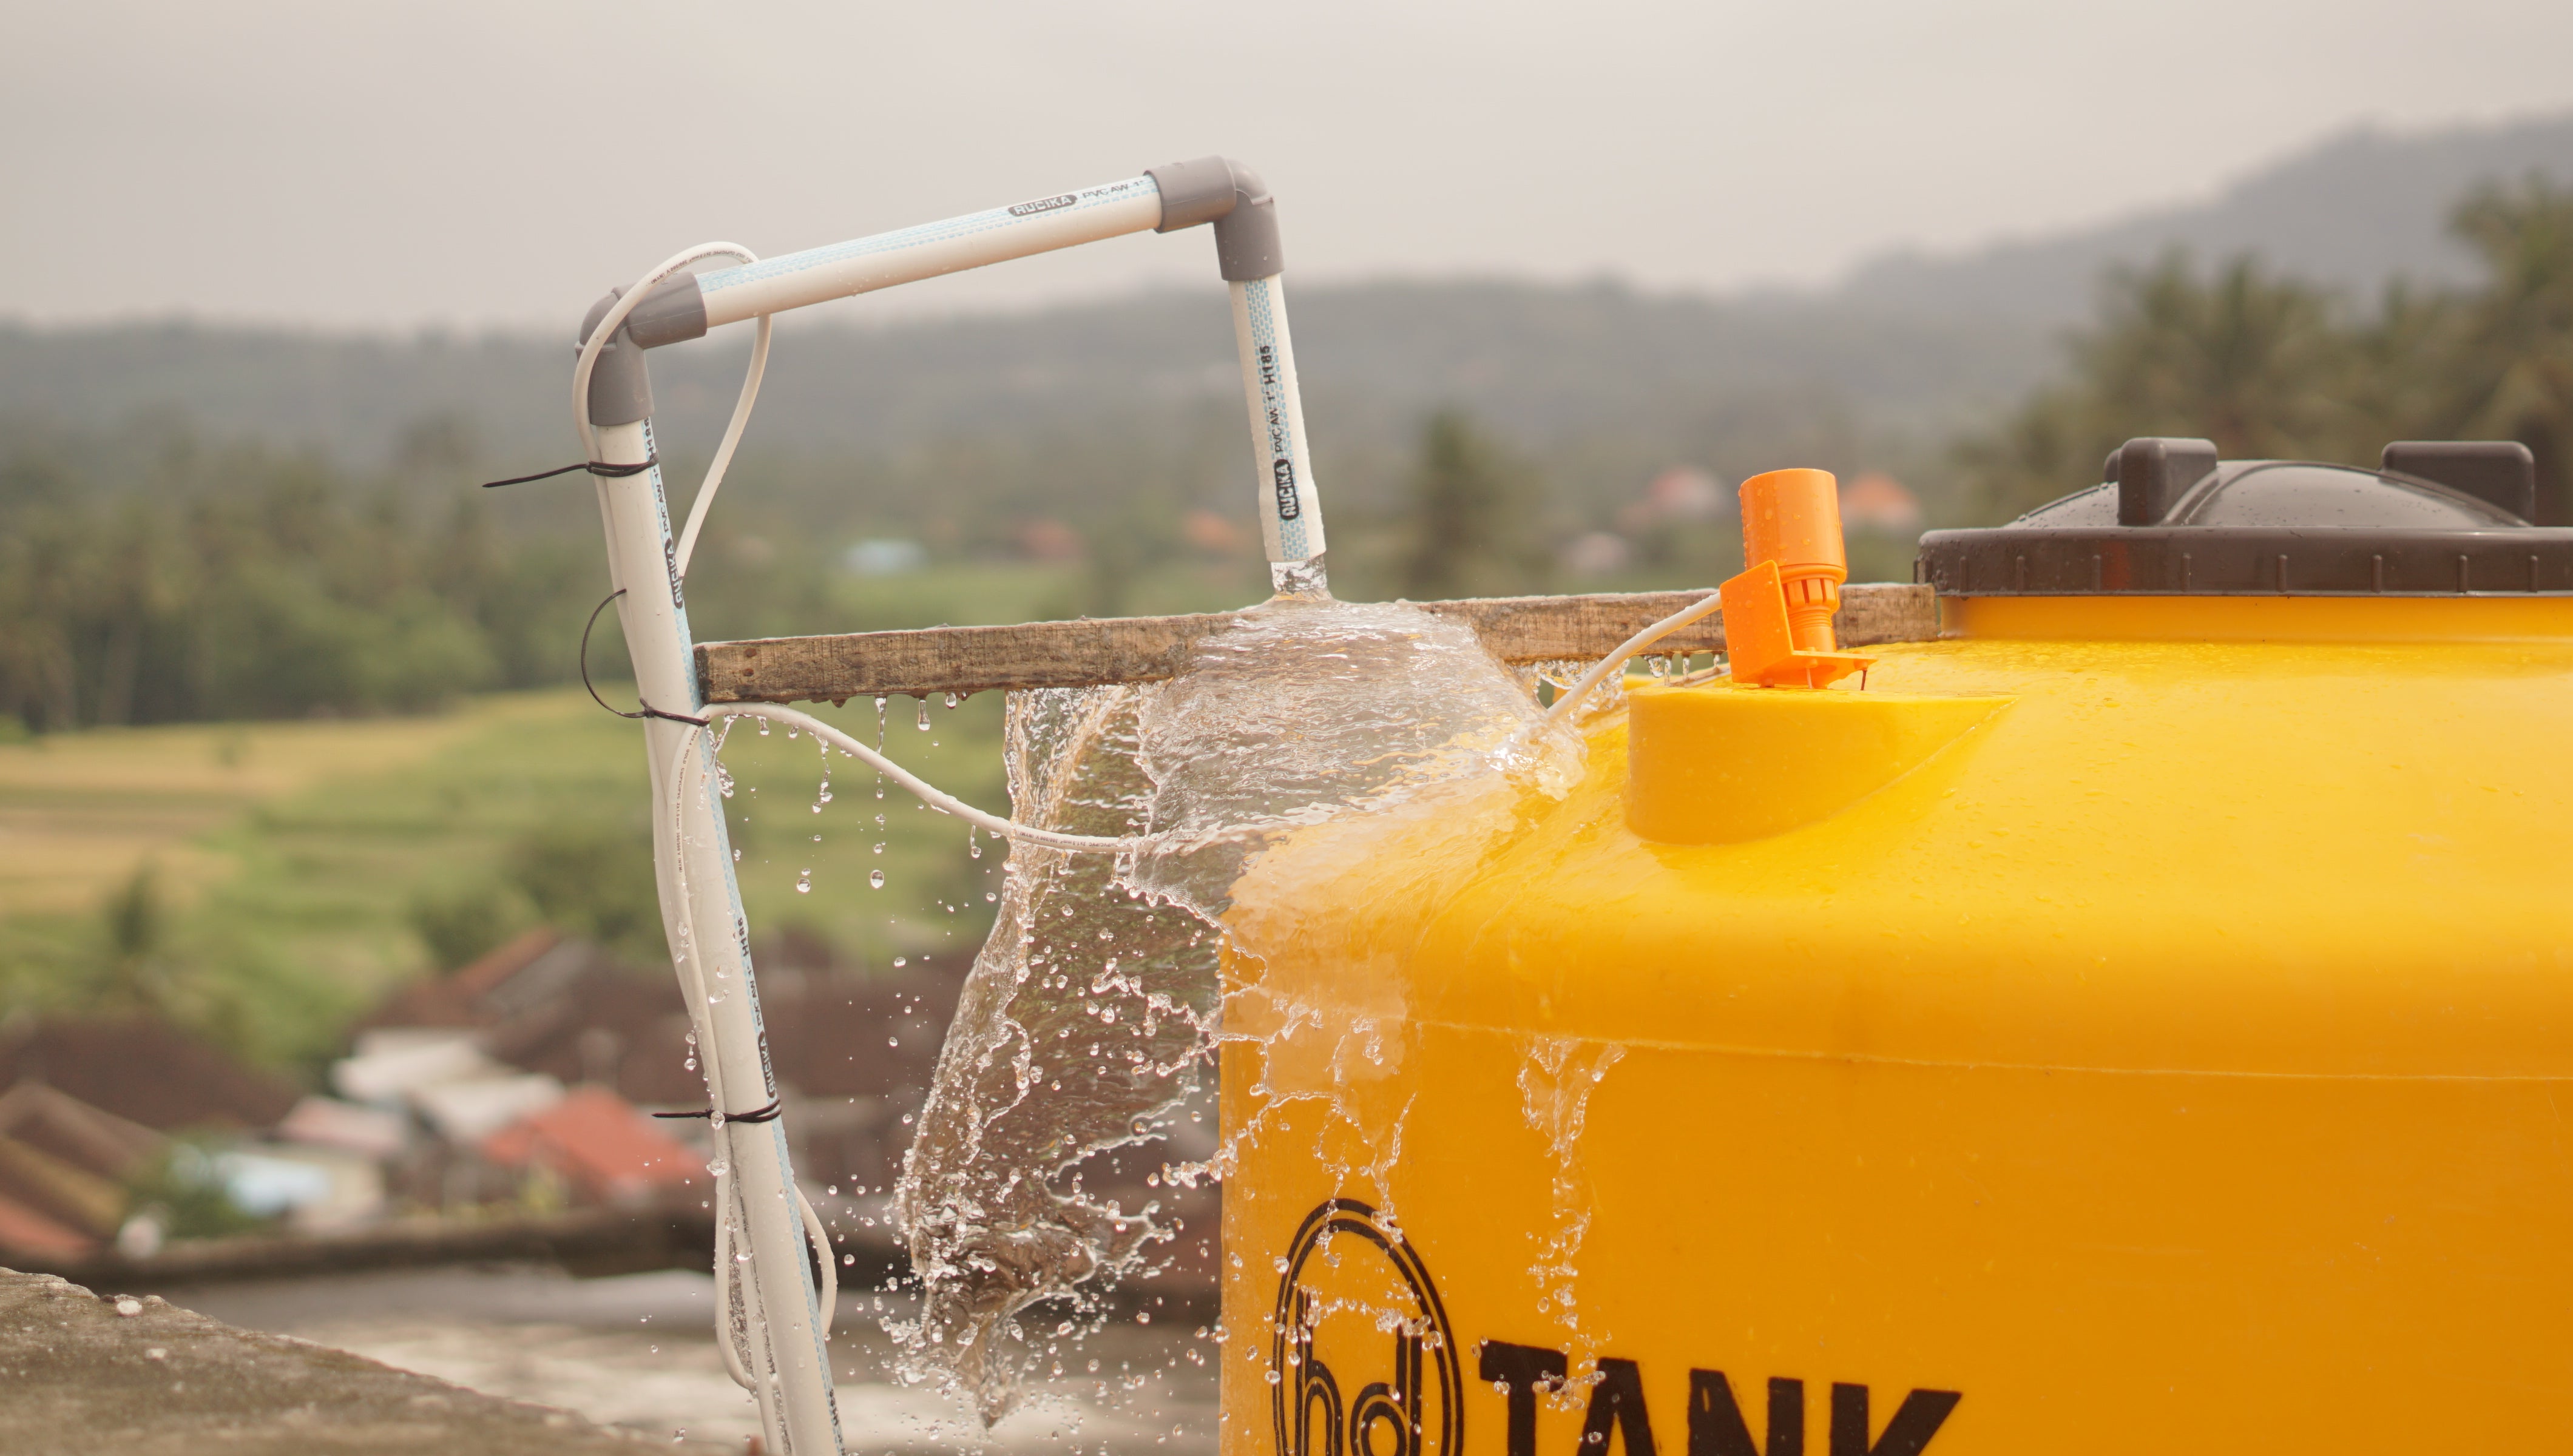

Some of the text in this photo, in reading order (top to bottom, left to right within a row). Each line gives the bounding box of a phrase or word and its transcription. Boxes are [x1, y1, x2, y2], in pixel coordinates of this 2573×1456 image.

[1013, 195, 1073, 215] RUCIKA
[1082, 188, 1109, 199] PVC
[1111, 183, 1129, 193] AW
[1259, 345, 1276, 385] H185
[1269, 405, 1280, 425] AW
[1272, 427, 1283, 453] PVC
[656, 484, 664, 503] AW
[1275, 463, 1297, 517] RUCIKA
[660, 505, 669, 533] PVC
[667, 544, 683, 604] RUCIKA
[750, 980, 757, 998] AW
[760, 1036, 776, 1093] RUCIKA
